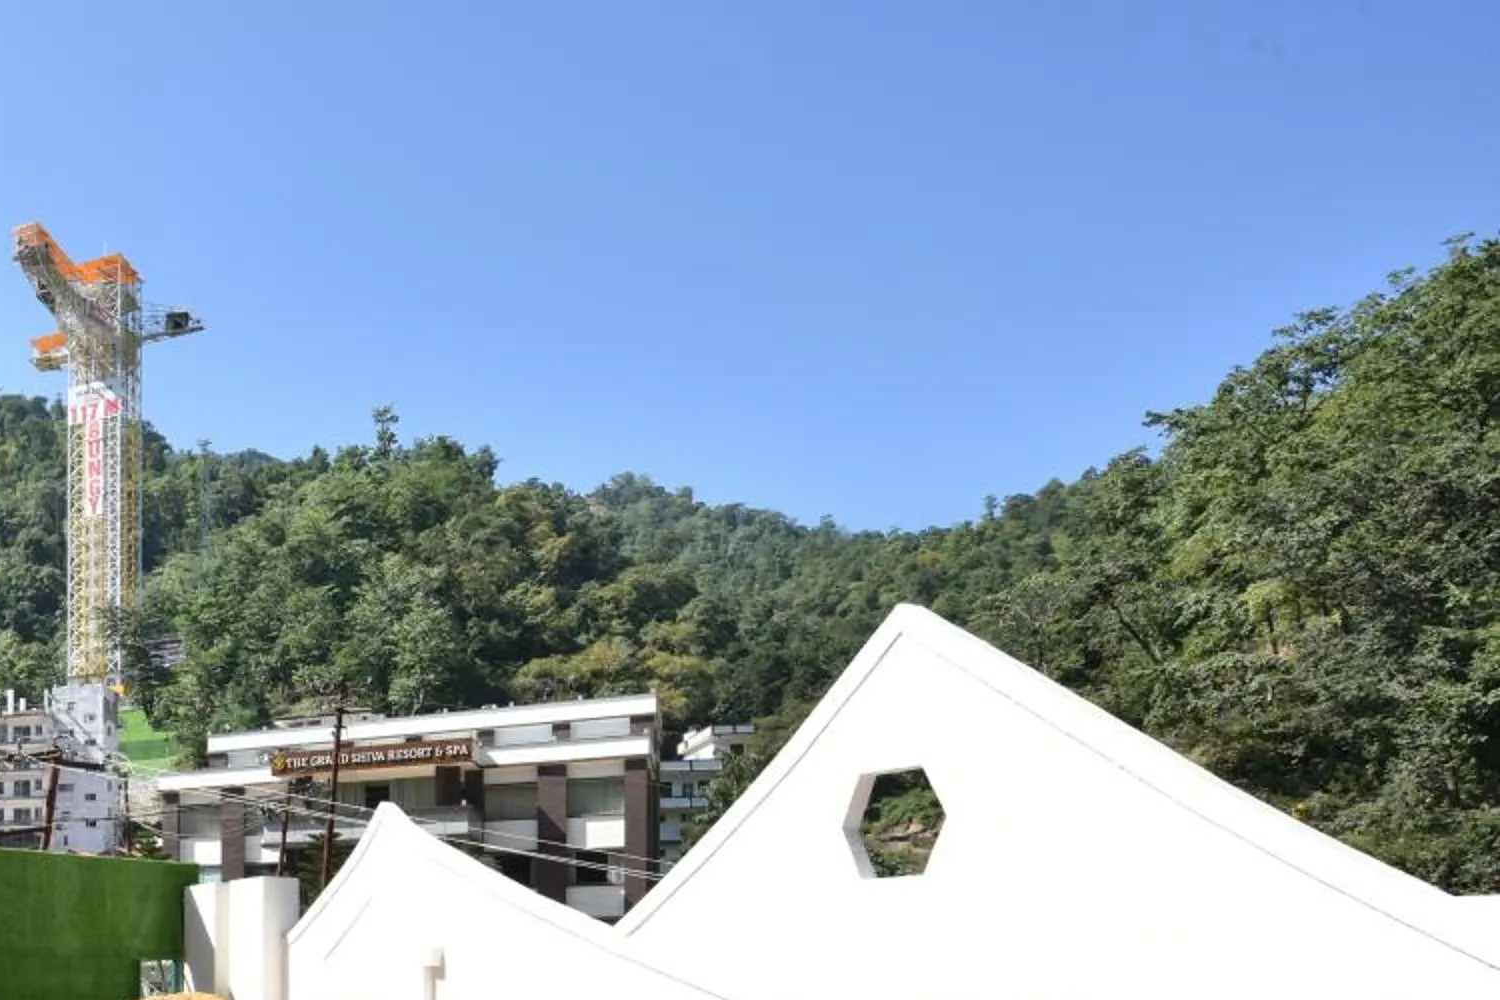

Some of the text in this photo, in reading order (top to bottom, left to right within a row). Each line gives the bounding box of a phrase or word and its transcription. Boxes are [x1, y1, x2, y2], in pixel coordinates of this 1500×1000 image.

[286, 756, 308, 768] THE
[351, 751, 385, 764] SHIVA
[387, 746, 433, 761] RESORT
[445, 743, 468, 756] SPA
